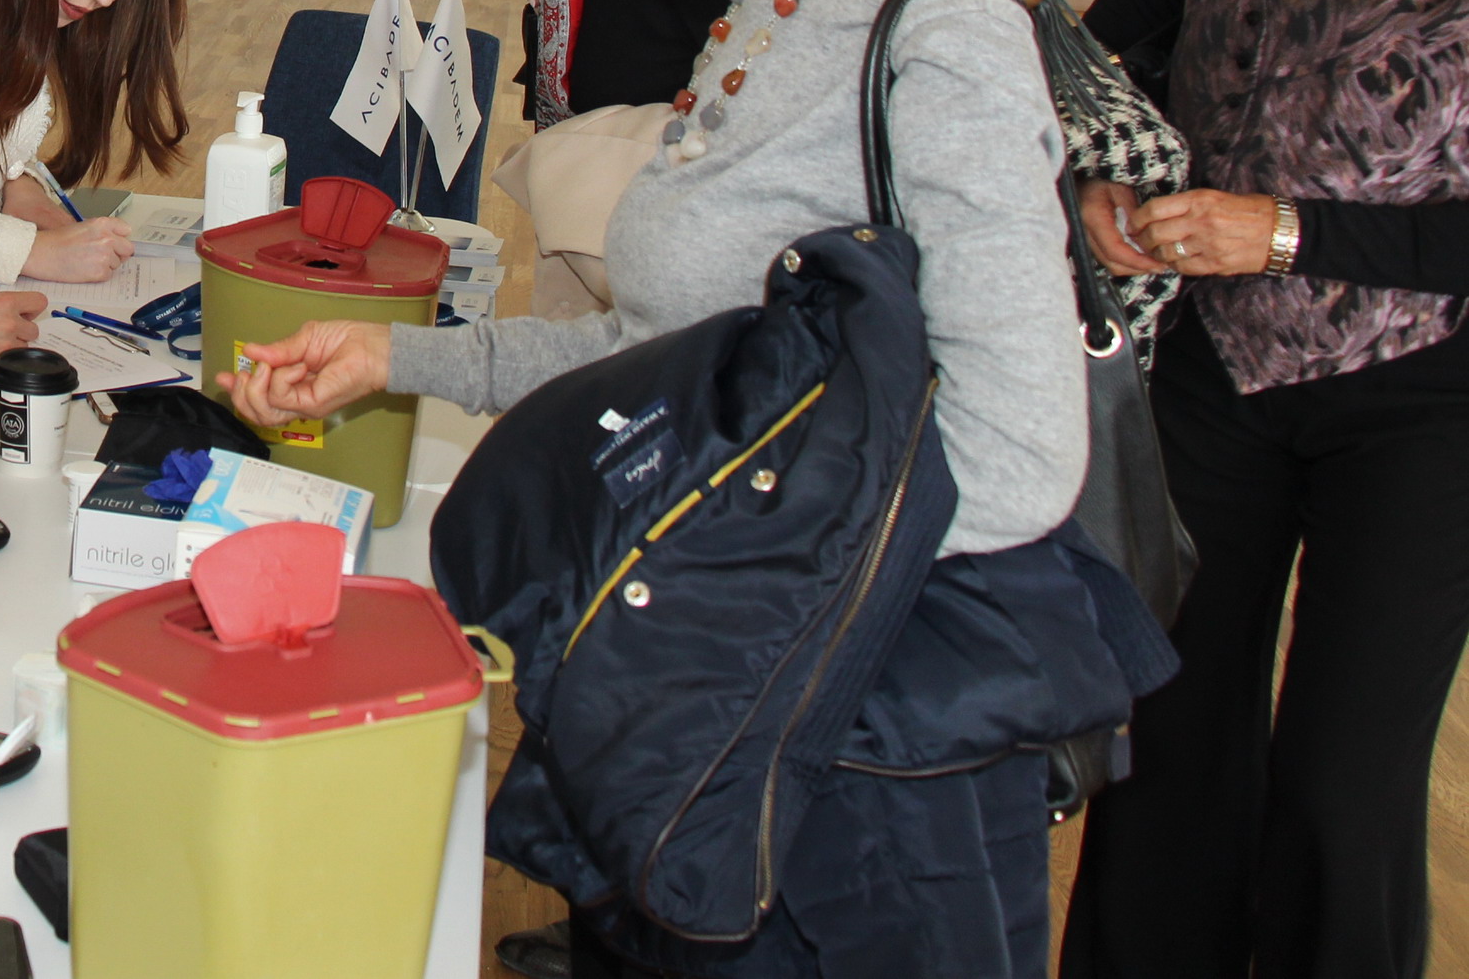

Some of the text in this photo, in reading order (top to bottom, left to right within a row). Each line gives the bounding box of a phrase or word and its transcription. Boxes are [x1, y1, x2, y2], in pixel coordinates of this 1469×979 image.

[89, 497, 134, 510] nitril
[87, 545, 144, 568] nitrile
[151, 552, 175, 576] gl
